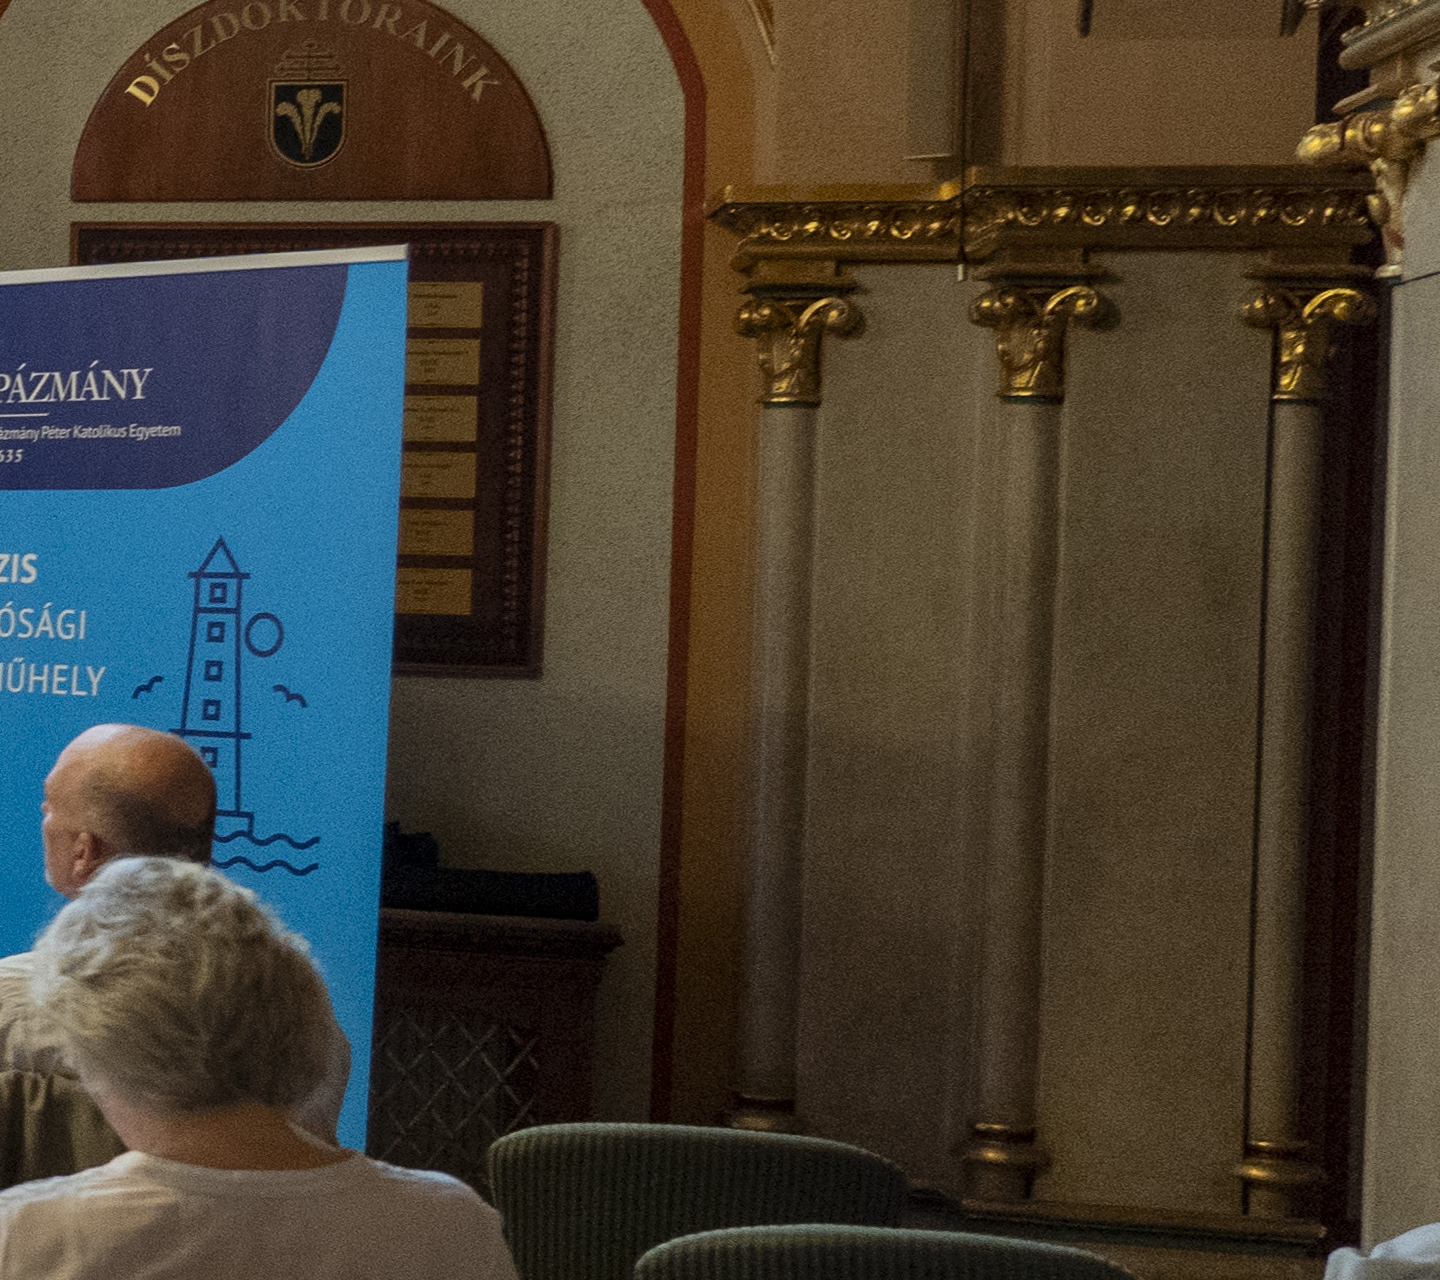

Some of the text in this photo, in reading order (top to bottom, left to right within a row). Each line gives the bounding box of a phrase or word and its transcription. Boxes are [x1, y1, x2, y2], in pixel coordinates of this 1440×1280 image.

[41, 424, 71, 439] Péter
[73, 424, 128, 439] Katolikus
[129, 423, 182, 441] Egyetem
